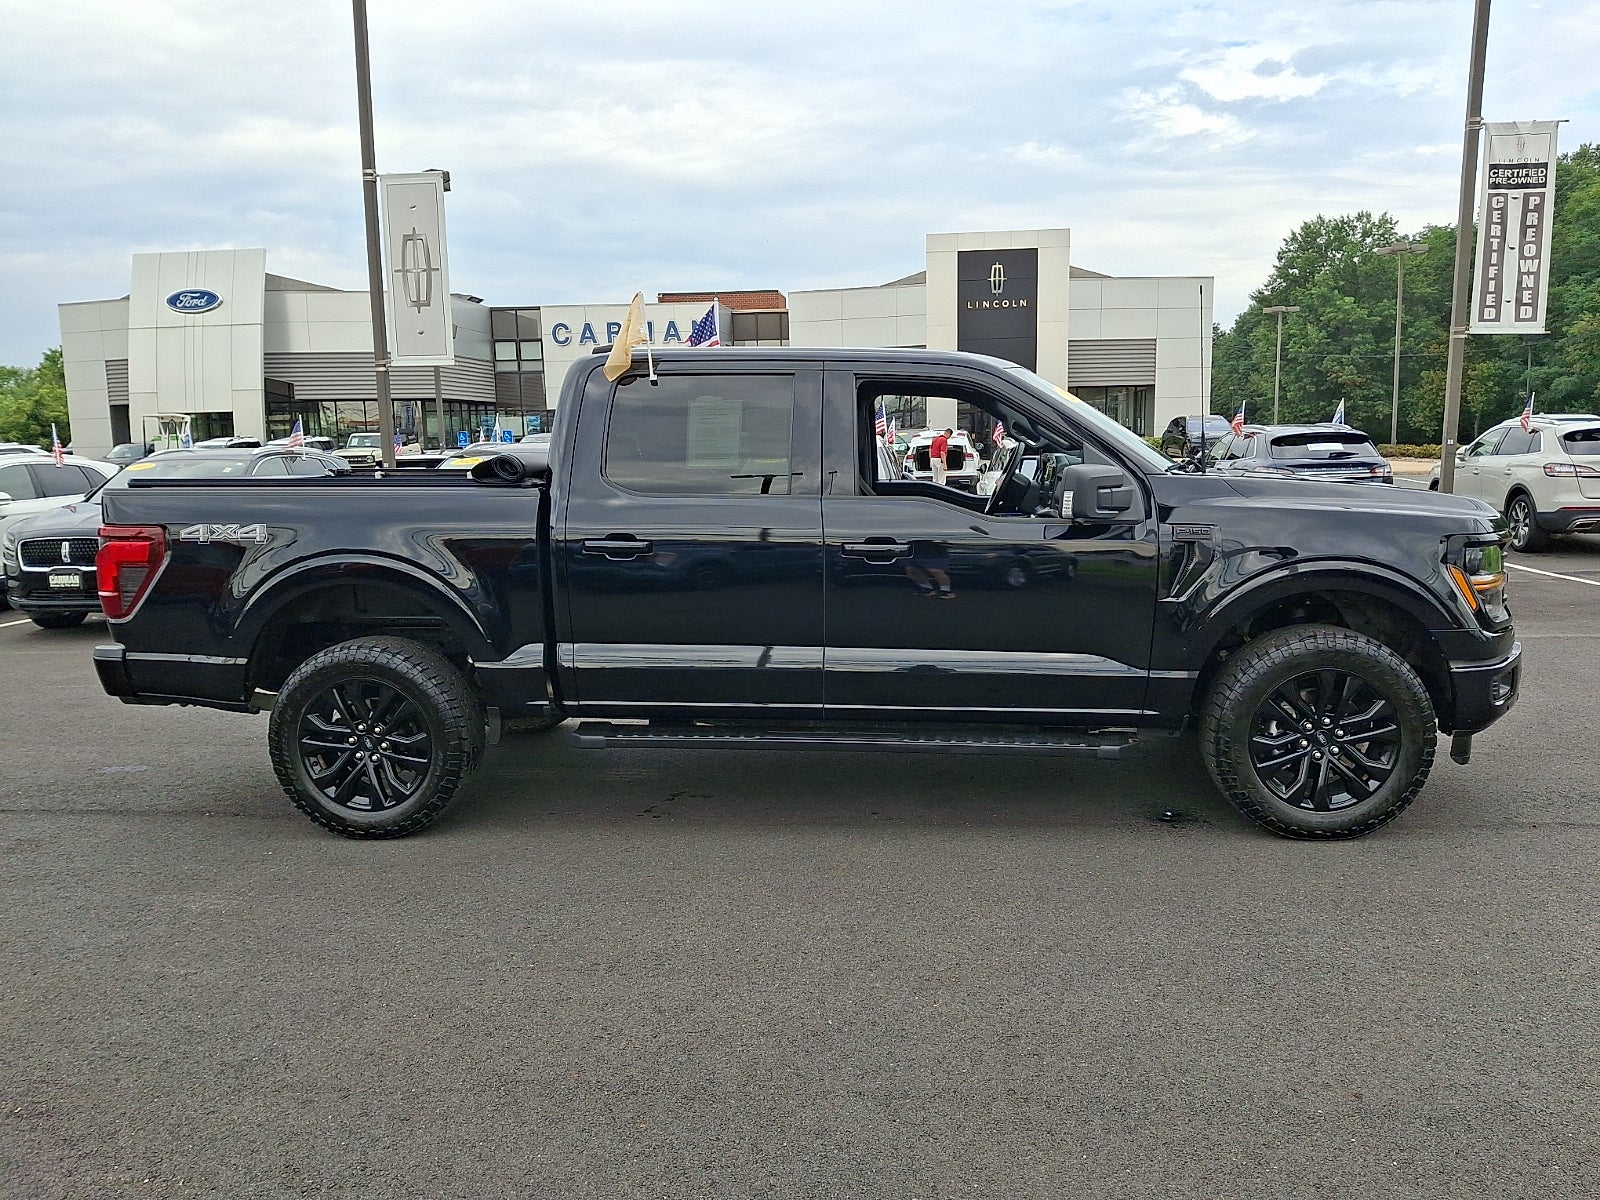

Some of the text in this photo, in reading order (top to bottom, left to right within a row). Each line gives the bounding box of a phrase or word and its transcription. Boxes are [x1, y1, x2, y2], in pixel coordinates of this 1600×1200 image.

[1490, 168, 1546, 177] CERTIFIED
[1489, 177, 1546, 185] PRE-OWNED
[1483, 196, 1505, 320] CERTIFIED
[1519, 196, 1541, 319] PREOWNED
[176, 292, 208, 307] Ford
[967, 299, 1028, 309] LINCOLN
[551, 319, 704, 346] CARA
[1176, 527, 1211, 536] F-150
